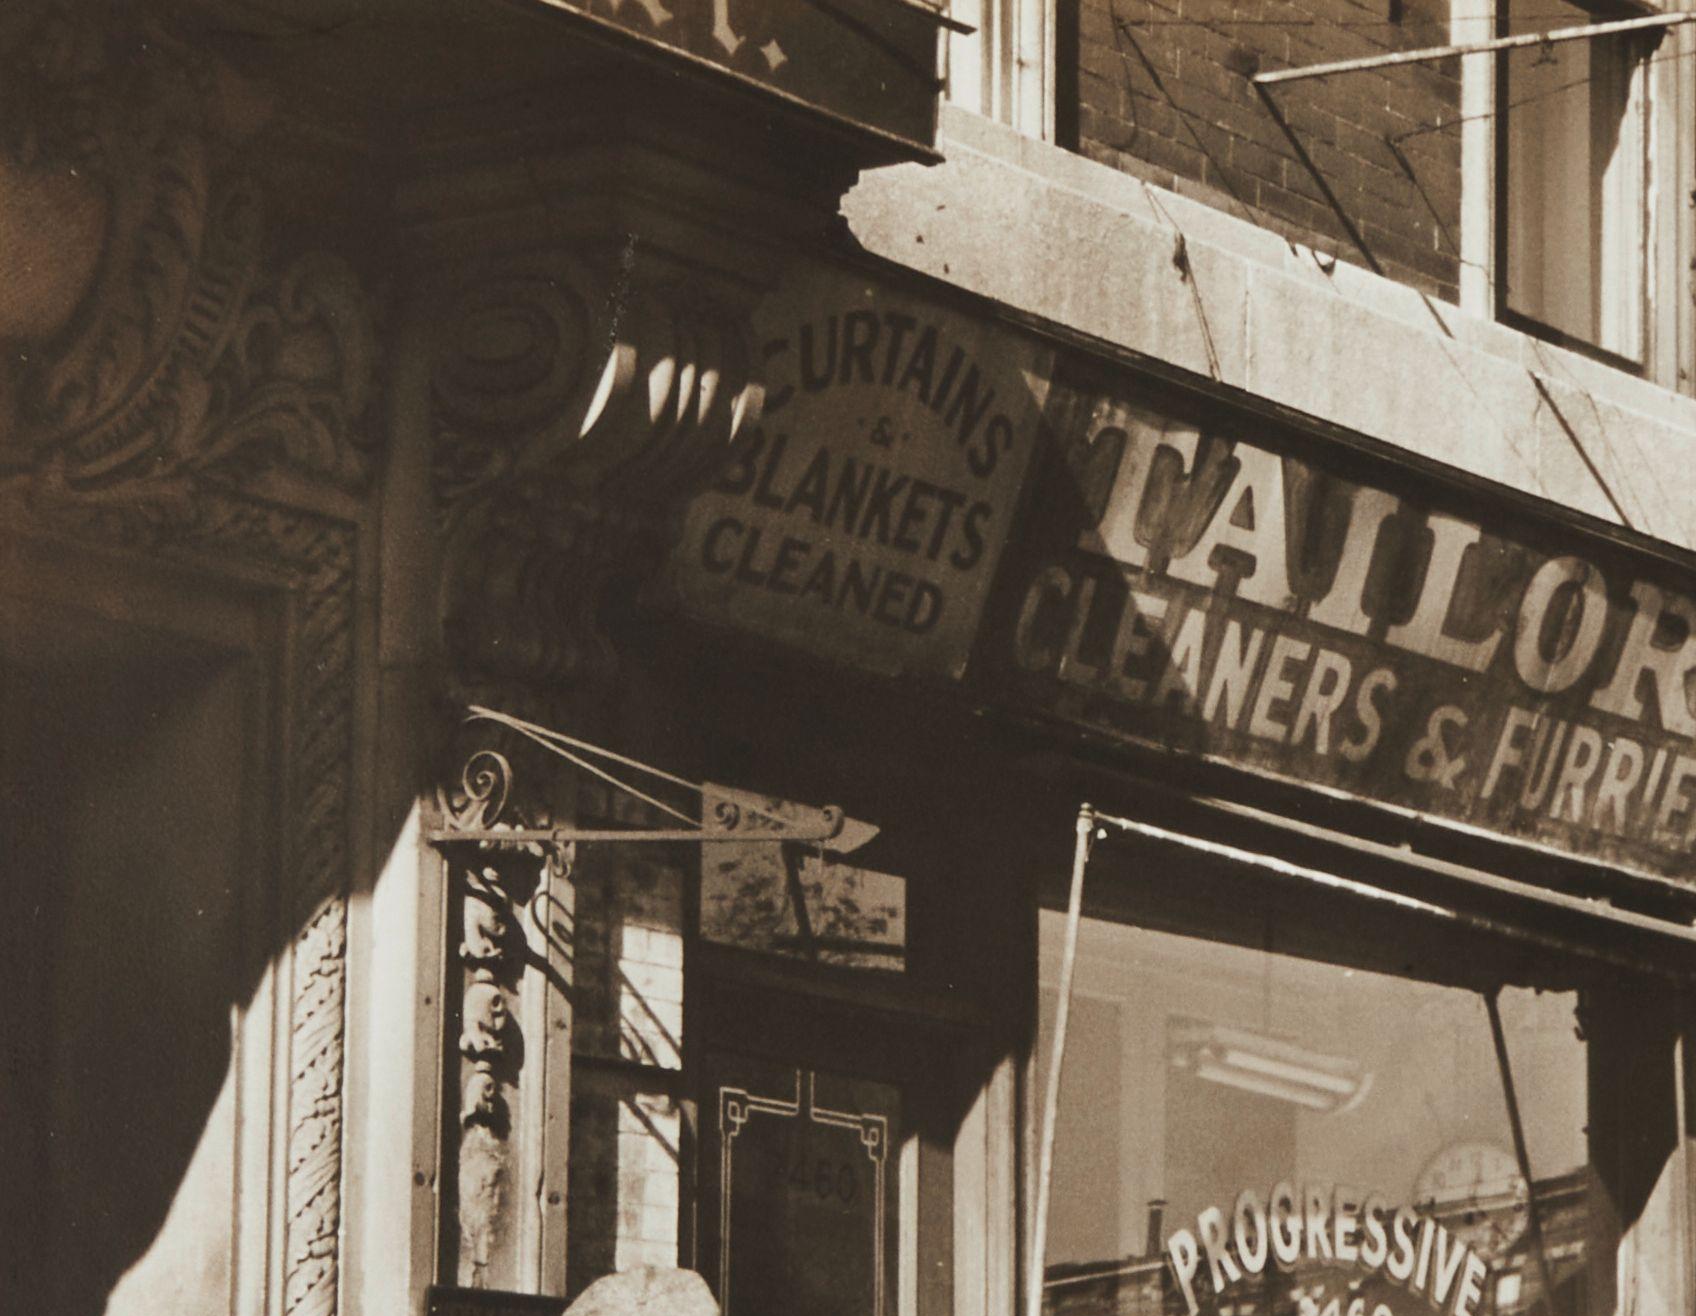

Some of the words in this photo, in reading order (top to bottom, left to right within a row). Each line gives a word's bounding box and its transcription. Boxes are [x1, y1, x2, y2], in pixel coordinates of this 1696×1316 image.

[714, 427, 992, 571] BLANKETS
[702, 517, 945, 634] CLEANED
[1015, 565, 1398, 762] CLEANERS
[1404, 705, 1470, 790] &
